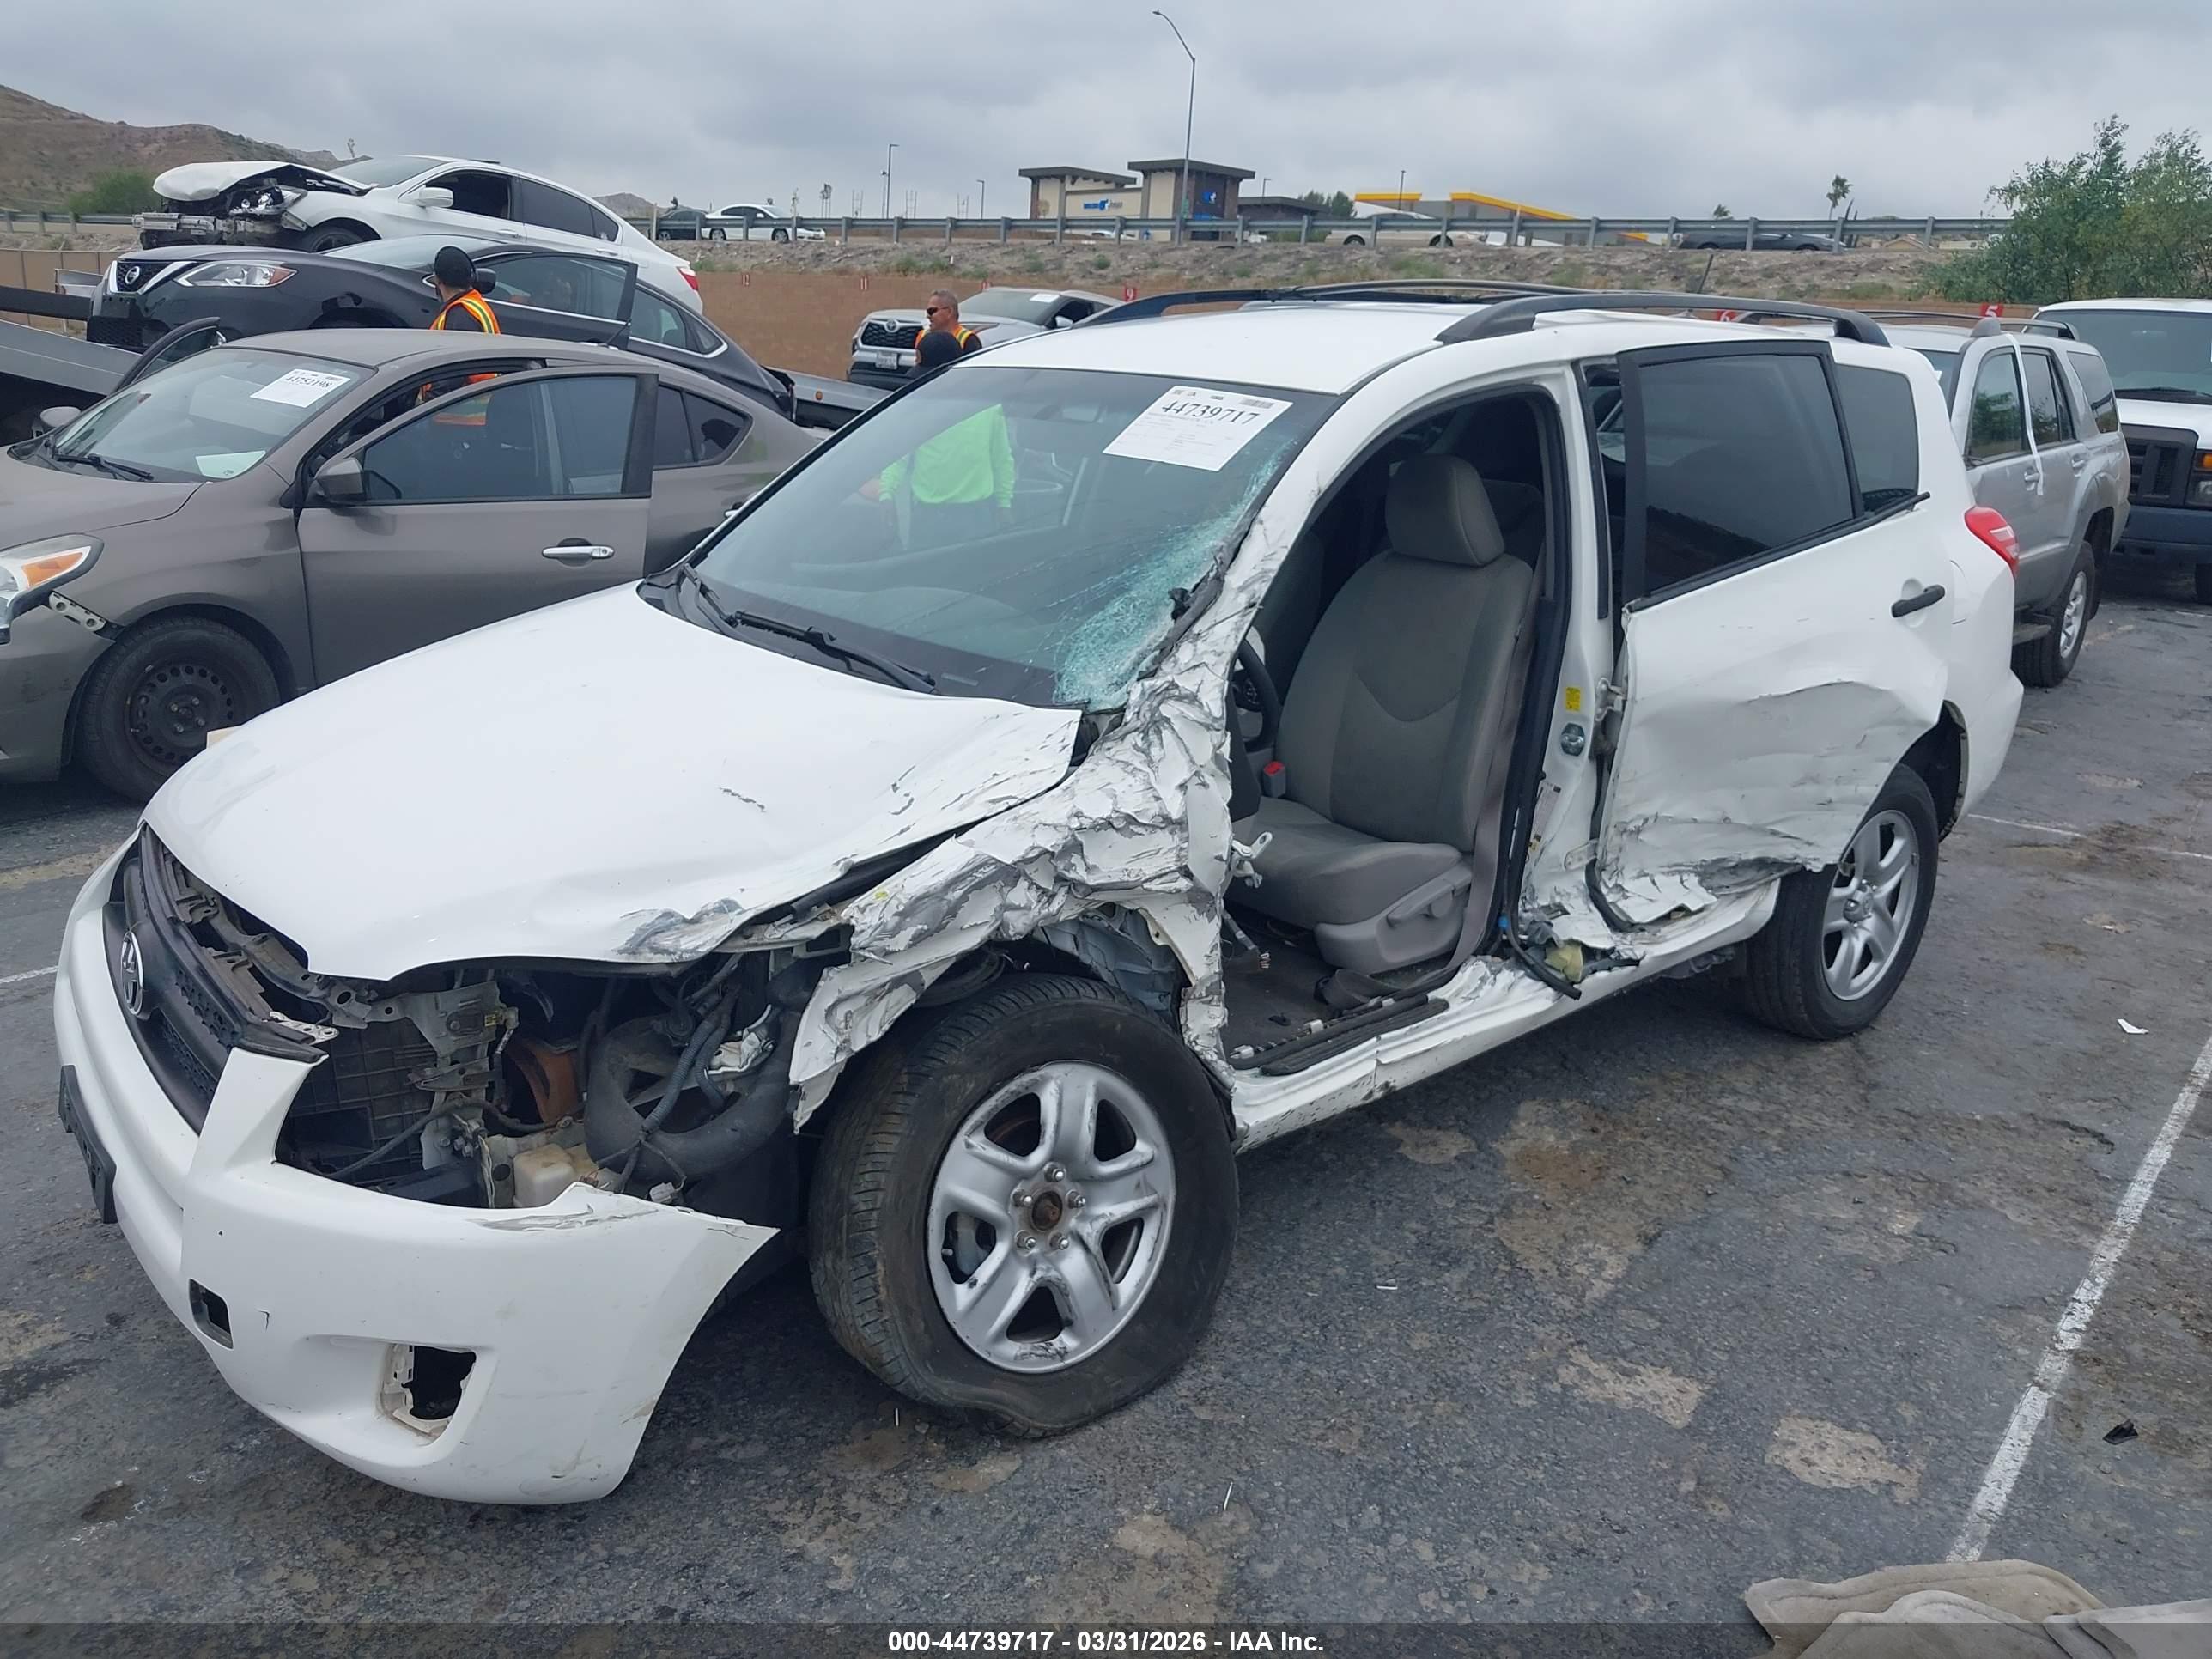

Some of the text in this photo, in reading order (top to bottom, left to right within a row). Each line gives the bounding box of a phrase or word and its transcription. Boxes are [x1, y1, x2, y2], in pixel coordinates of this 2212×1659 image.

[1126, 288, 1134, 301] 9
[1985, 305, 1998, 318] 5
[1162, 401, 1260, 425] 44739717
